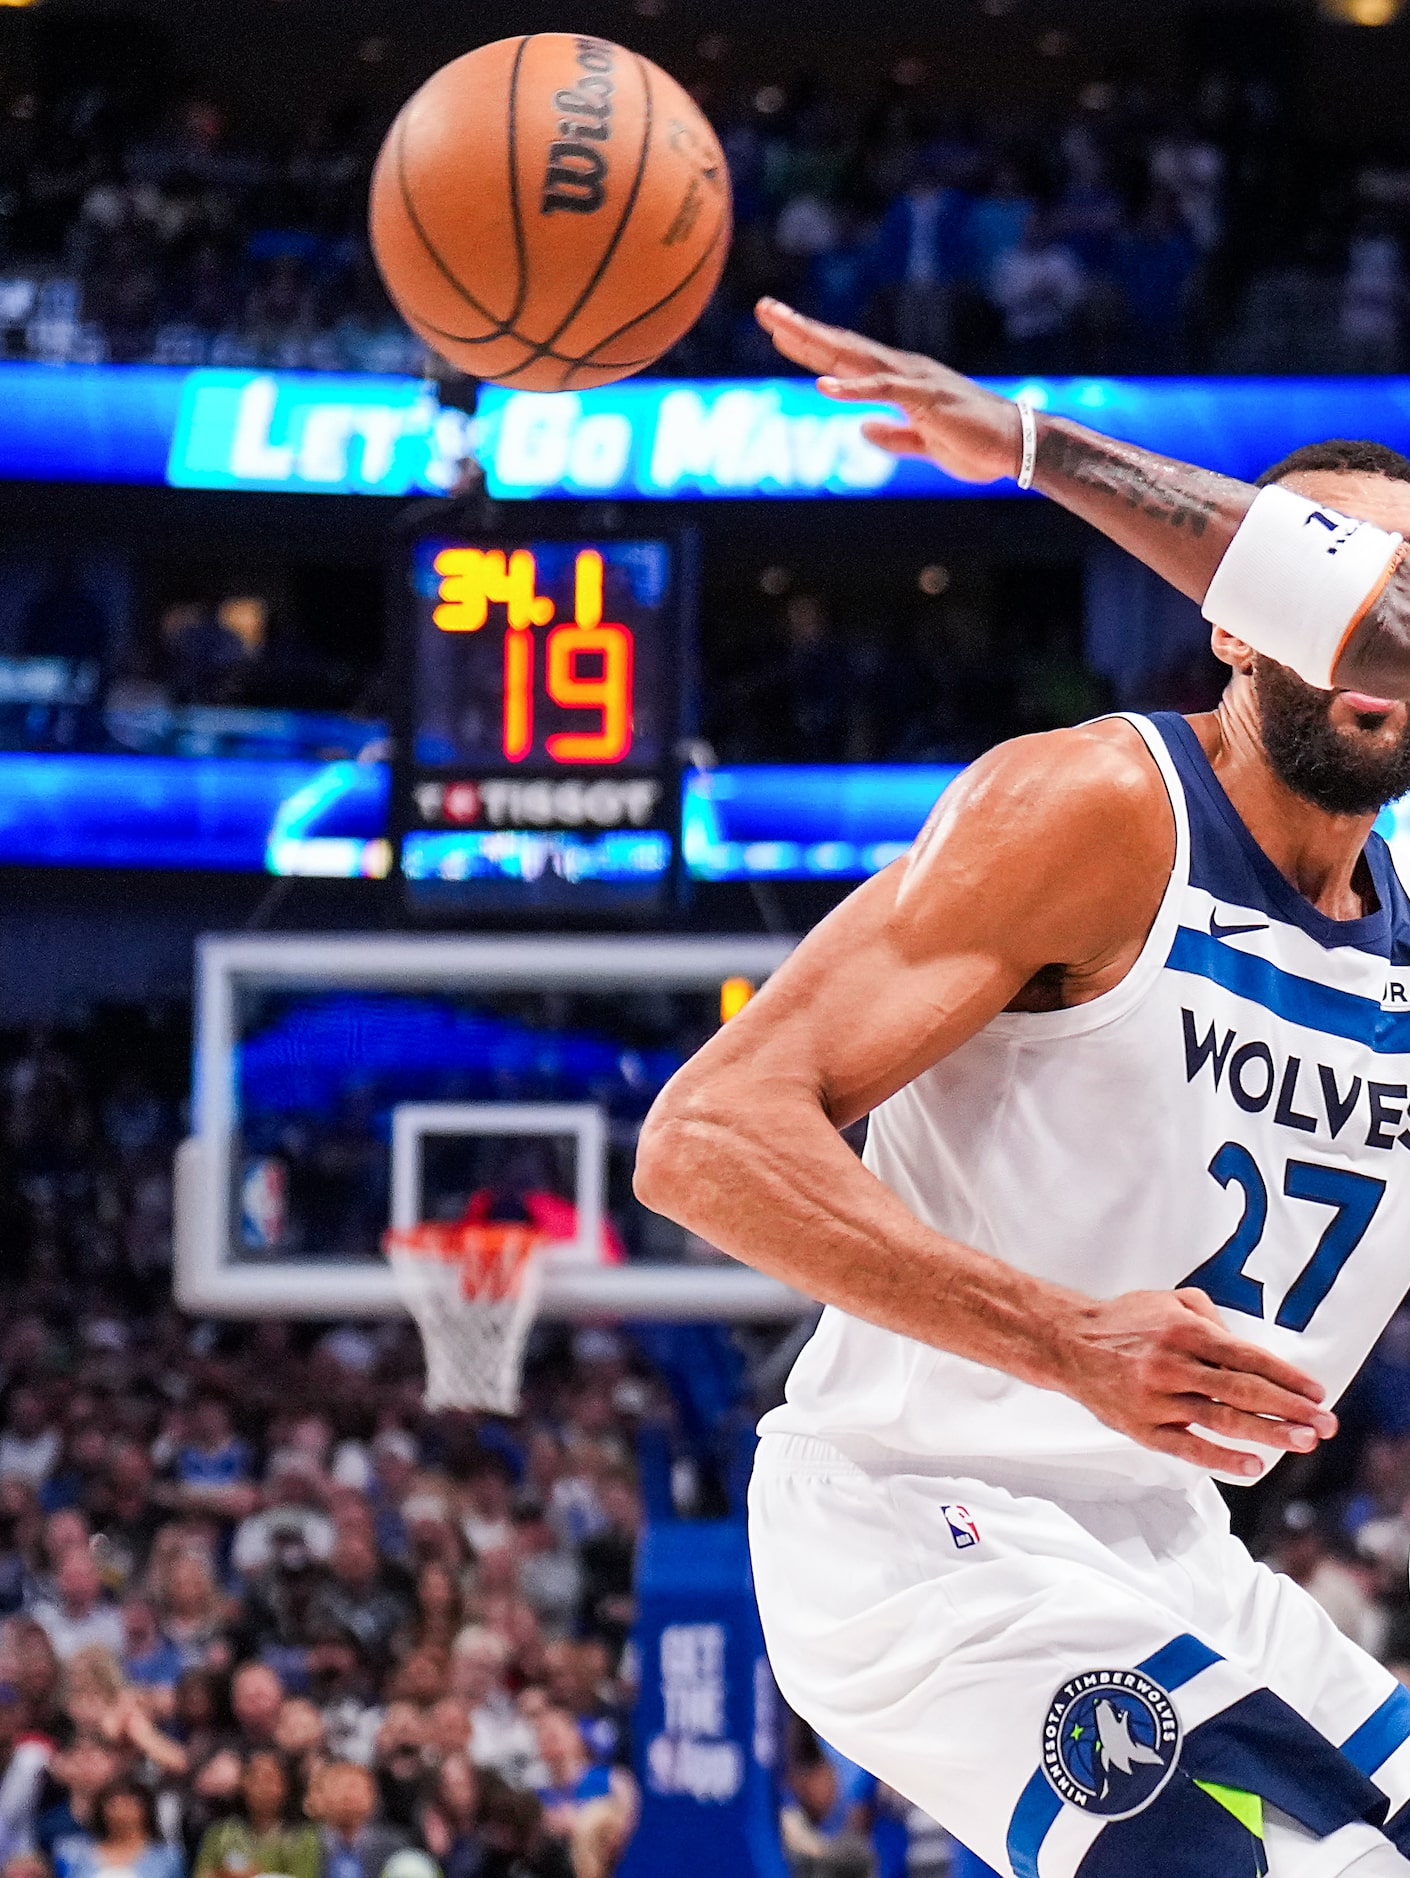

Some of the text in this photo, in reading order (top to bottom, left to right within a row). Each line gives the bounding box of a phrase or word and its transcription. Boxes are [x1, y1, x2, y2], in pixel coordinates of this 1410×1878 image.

[541, 37, 617, 217] Wilson
[433, 548, 603, 631] 34.1
[503, 622, 633, 764] 19
[1176, 1140, 1387, 1333] 27
[1043, 1672, 1176, 1806] MINNESOTA TIMBERWOLVES
